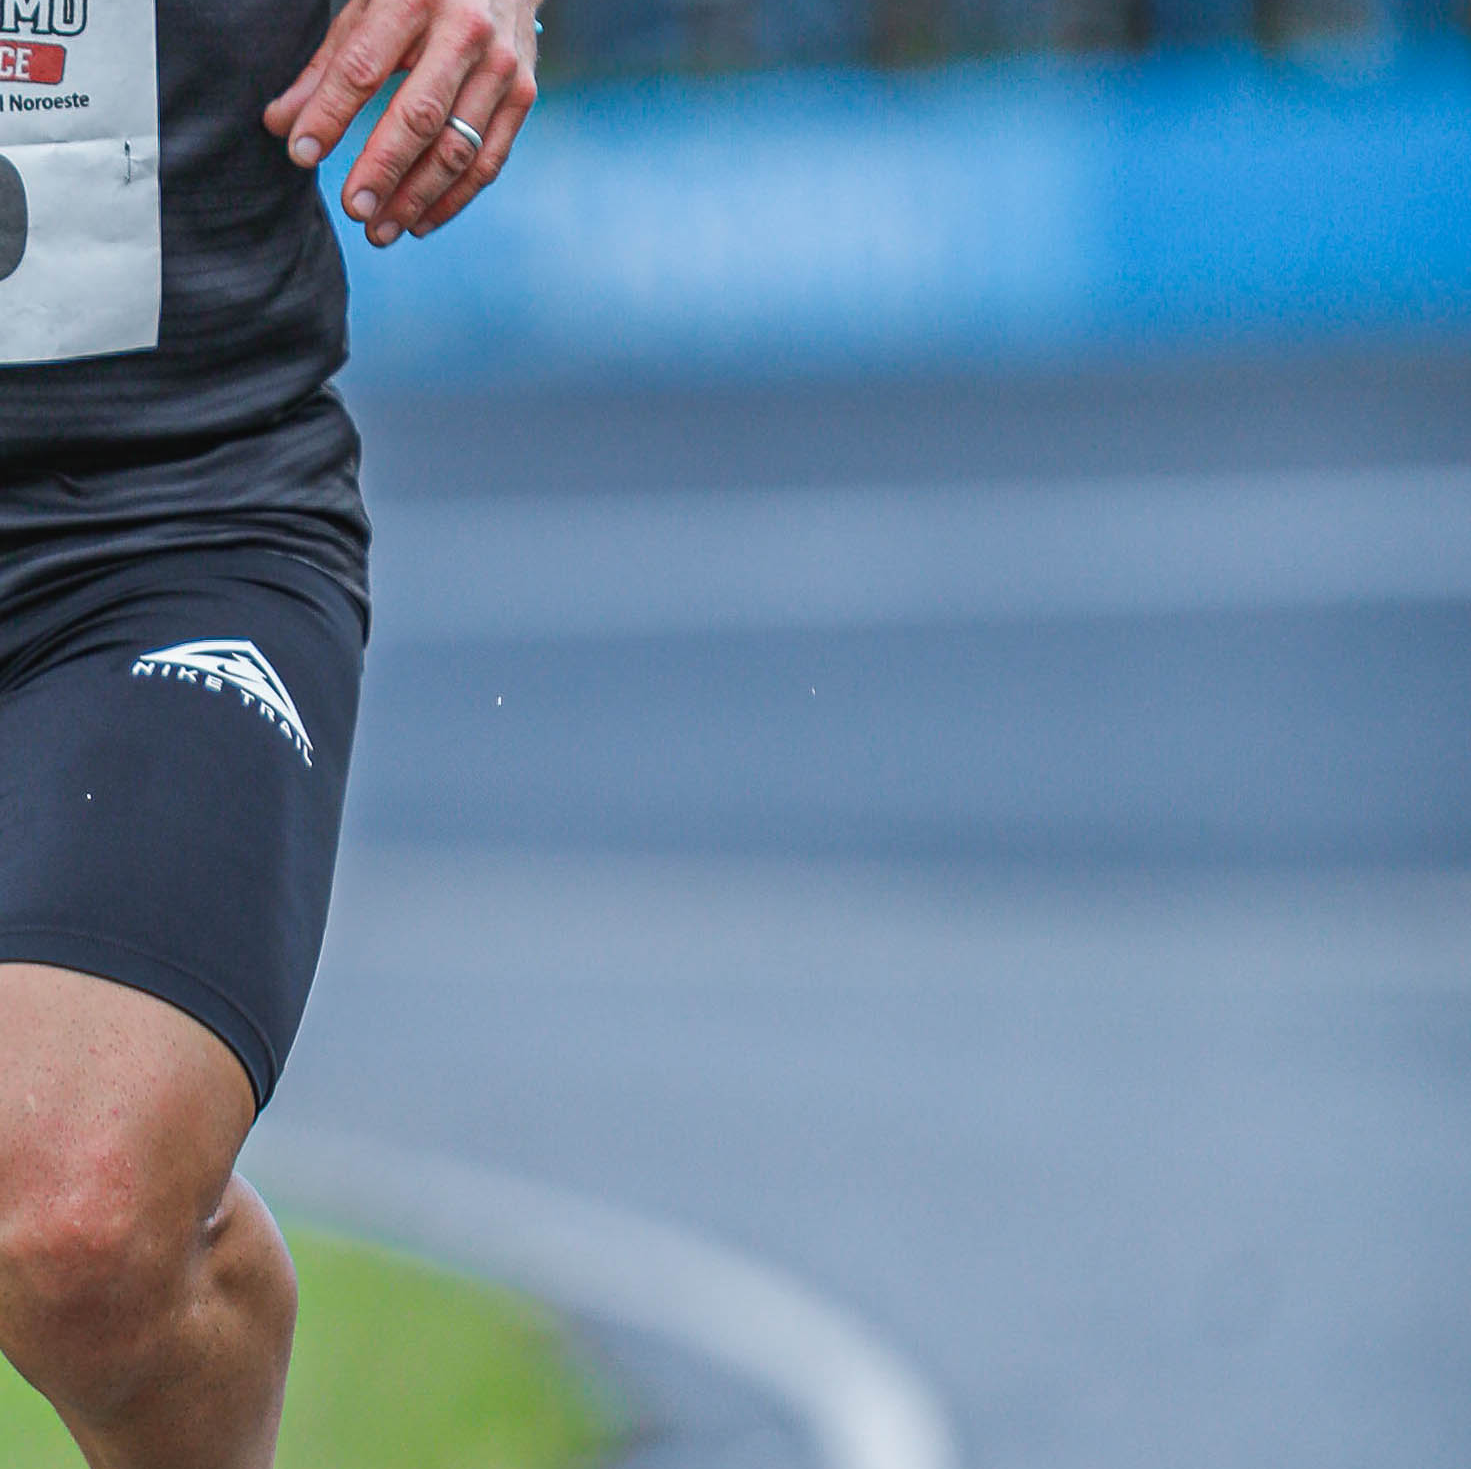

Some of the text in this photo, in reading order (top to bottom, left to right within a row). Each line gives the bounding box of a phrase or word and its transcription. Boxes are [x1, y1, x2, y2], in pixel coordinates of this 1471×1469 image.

[9, 91, 90, 112] Noroeste
[131, 659, 313, 768] NIKE TRAIL
